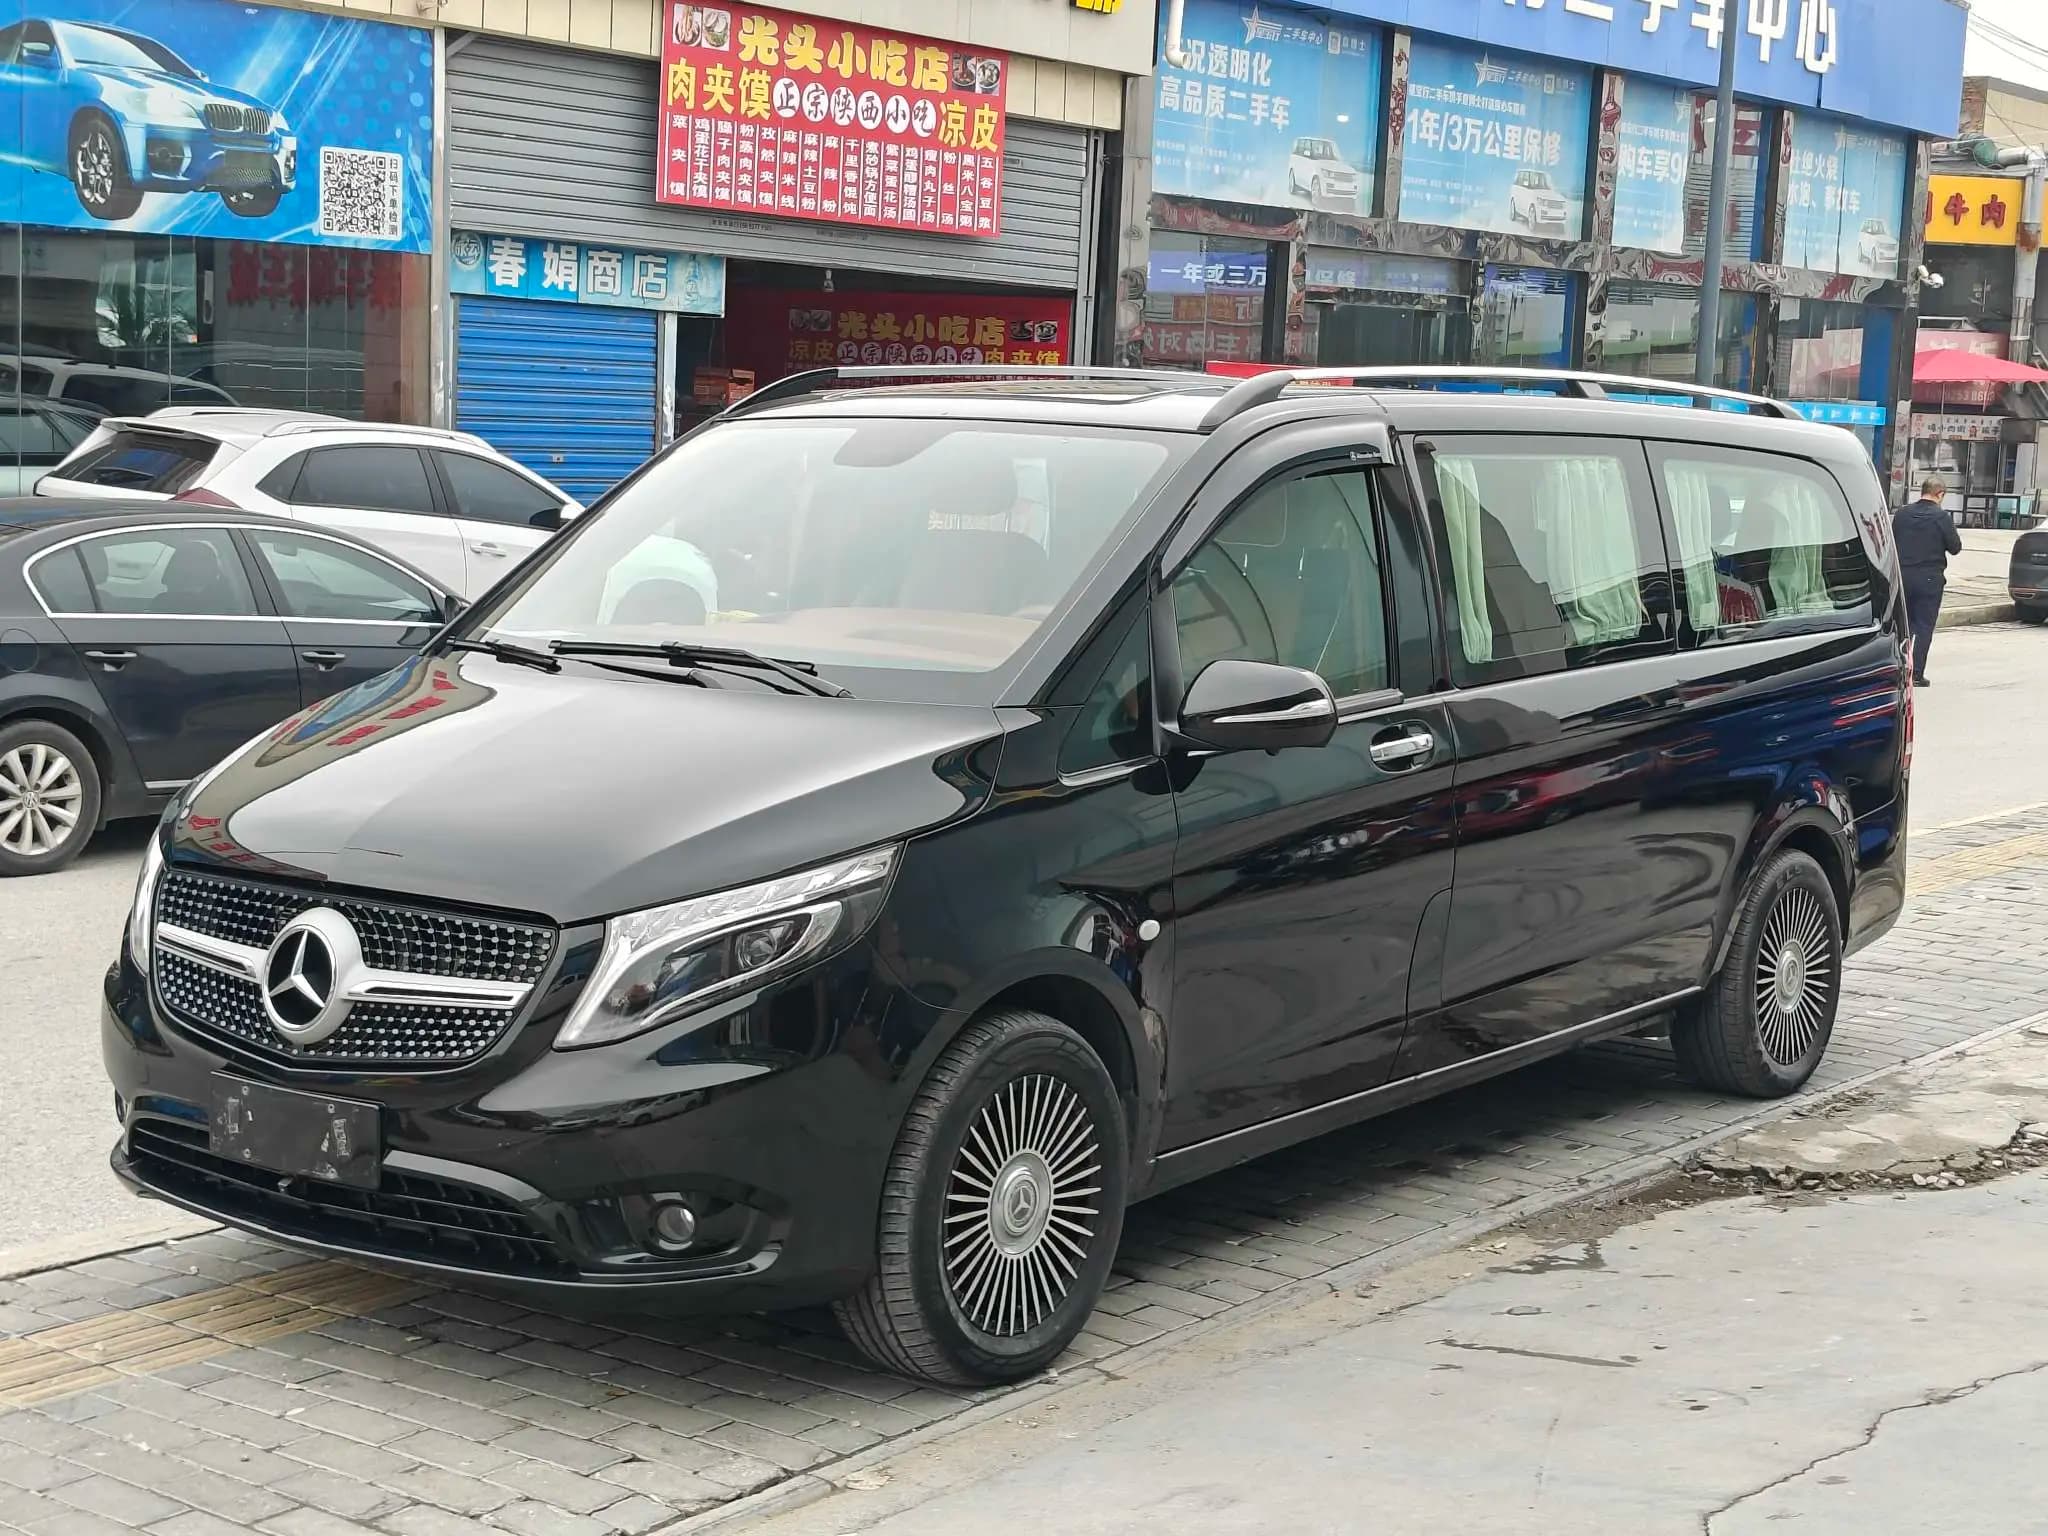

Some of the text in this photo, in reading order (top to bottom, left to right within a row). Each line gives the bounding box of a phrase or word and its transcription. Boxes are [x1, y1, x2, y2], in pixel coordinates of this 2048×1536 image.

[737, 15, 949, 94] 光头小吃店
[667, 57, 999, 153] 肉夹馍 正宗陕西小吃 凉皮
[1160, 75, 1291, 127] 高品质二手车
[1406, 108, 1561, 165] 1年/3万公里保修
[388, 158, 399, 236] 扫码下单检测
[758, 126, 777, 206] 孜然夹馍
[780, 129, 798, 209] 麻辣米线
[801, 132, 819, 211] 麻辣土豆粉
[822, 135, 840, 213] 麻辣粉
[843, 138, 860, 215] 千里香馄饨
[882, 143, 900, 220] 紫菜蛋花汤
[941, 151, 957, 226] 粉丝汤
[959, 154, 976, 228] 黑米八宝粥
[978, 157, 994, 229] 五谷豆浆
[488, 237, 669, 300] 春娟商店
[838, 310, 1005, 347] 光头小吃店
